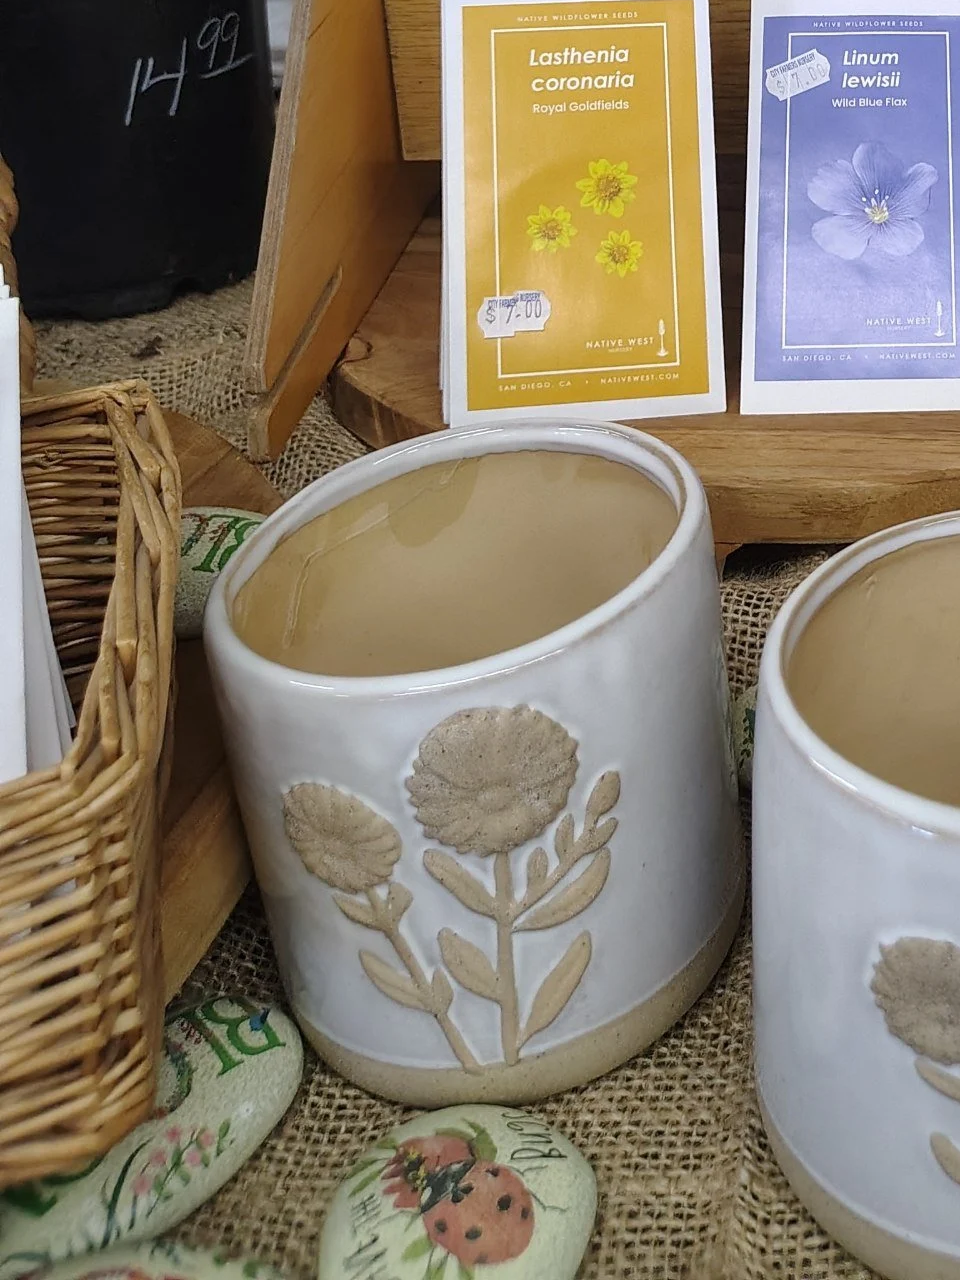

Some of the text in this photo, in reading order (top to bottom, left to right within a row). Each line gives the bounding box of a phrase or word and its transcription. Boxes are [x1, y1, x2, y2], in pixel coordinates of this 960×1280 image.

[552, 13, 608, 21] WILDFLOWER
[612, 11, 638, 19] SEEDS
[529, 45, 630, 67] Lasthenia
[843, 50, 899, 66] Linum
[531, 71, 635, 92] coronaria
[842, 71, 901, 89] lewisii
[533, 99, 630, 116] Royal Goldfields
[832, 97, 908, 108] Wild Blue Flax
[866, 316, 932, 326] NATIVE WEST
[586, 336, 655, 349] NATIVE WEST
[879, 352, 956, 360] NATIVEWEST.COM
[498, 384, 516, 392] SAN
[558, 380, 572, 388] CA
[600, 373, 680, 385] NATIVEWEST.COM
